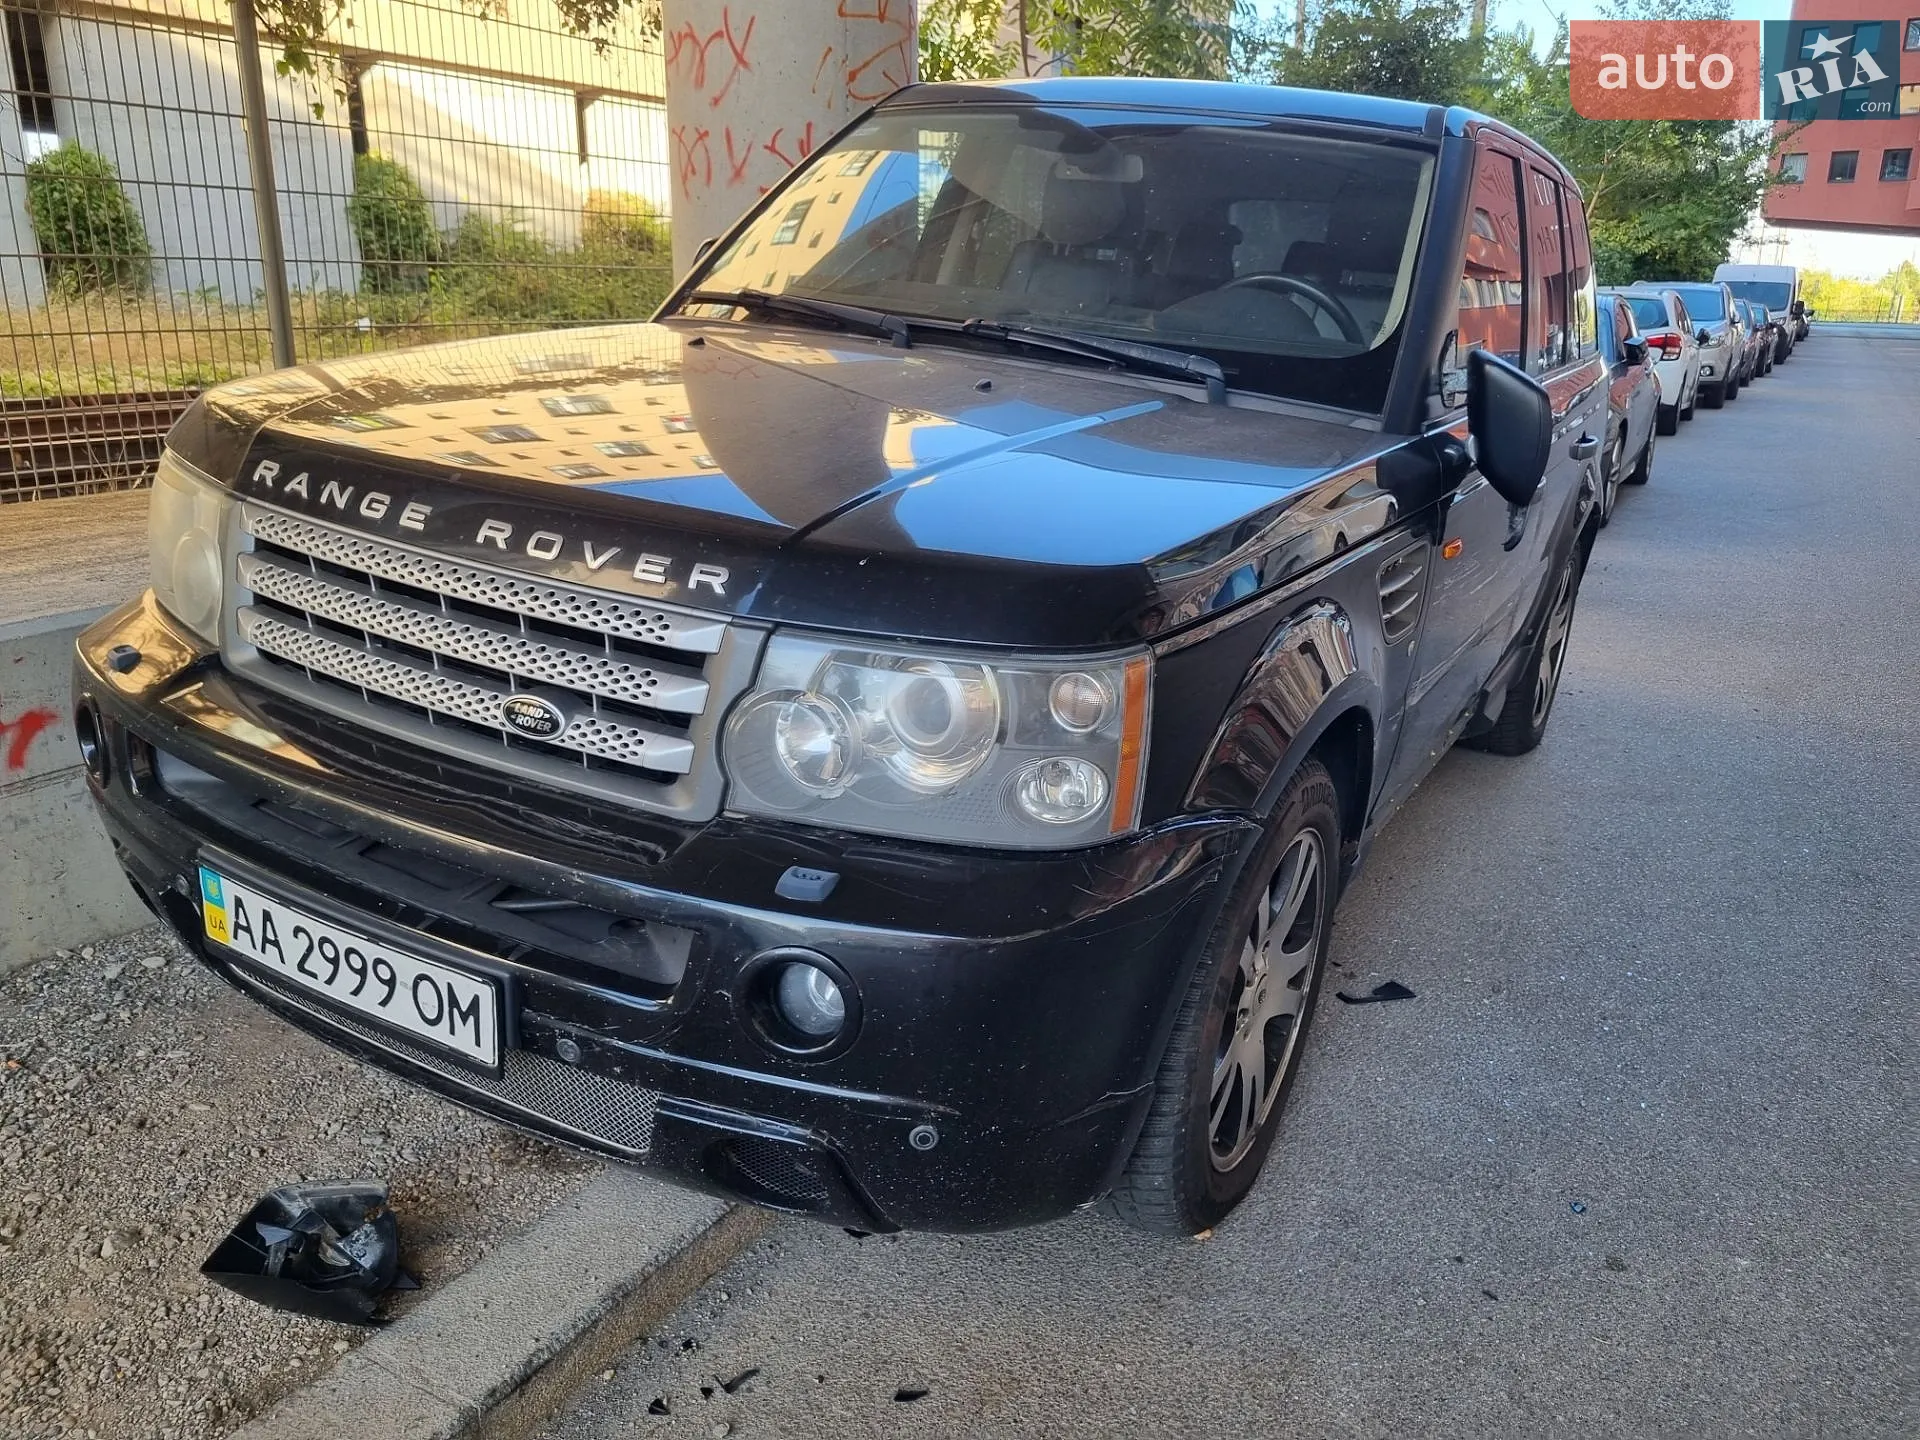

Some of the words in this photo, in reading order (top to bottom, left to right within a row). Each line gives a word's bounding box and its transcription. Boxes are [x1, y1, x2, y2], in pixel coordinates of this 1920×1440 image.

[252, 459, 433, 531] RANGE
[476, 518, 731, 594] ROVER
[514, 702, 544, 719] LAND
[515, 713, 552, 732] ROVER
[209, 917, 228, 934] UA
[232, 894, 286, 965] AA
[292, 924, 397, 1008] 2999
[412, 973, 482, 1049] OM
